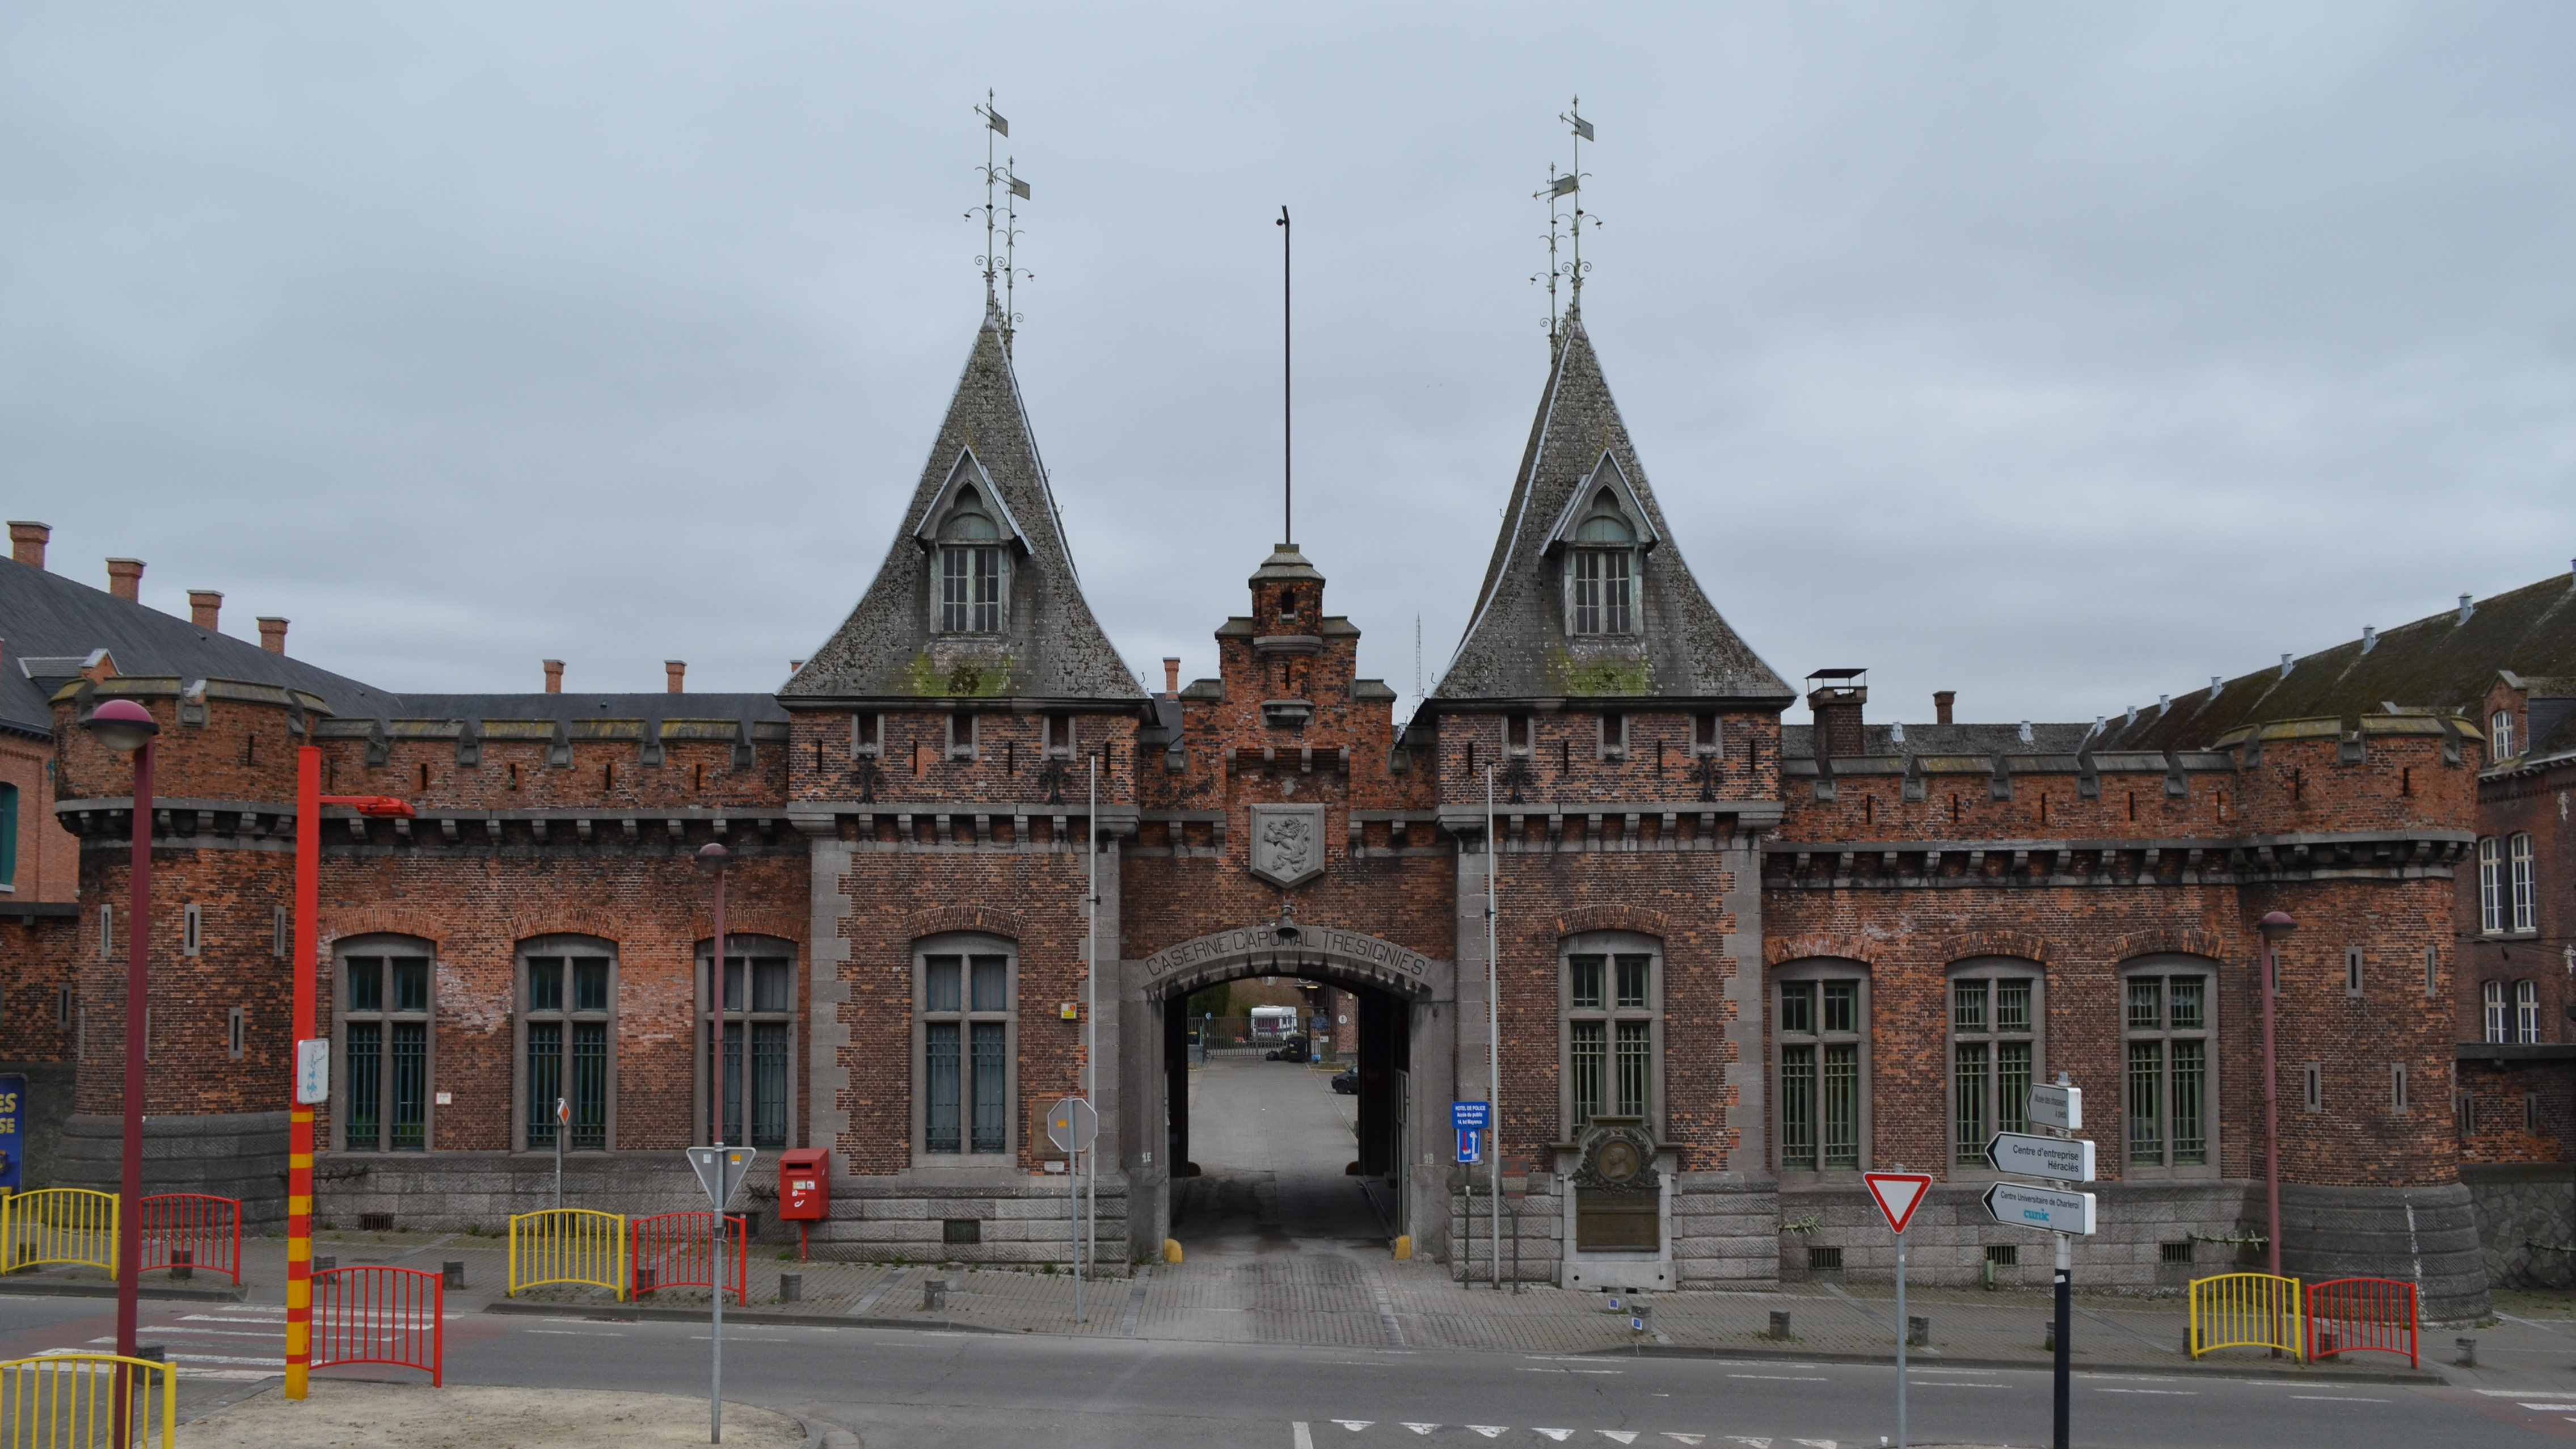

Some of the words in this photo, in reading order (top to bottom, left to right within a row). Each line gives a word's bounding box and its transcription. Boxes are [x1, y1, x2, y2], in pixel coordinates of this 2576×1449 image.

[1146, 936, 1230, 976] CASERNE
[1322, 930, 1425, 976] TRESIGNIES
[2013, 1144, 2035, 1156] Centre
[2037, 1147, 2078, 1161] d'entreprise
[2001, 1190, 2017, 1200] Centre
[2017, 1193, 2048, 1205] Universitaire
[2049, 1198, 2055, 1206] de
[2056, 1198, 2080, 1210] Charleroi
[2023, 1207, 2050, 1221] cunic
